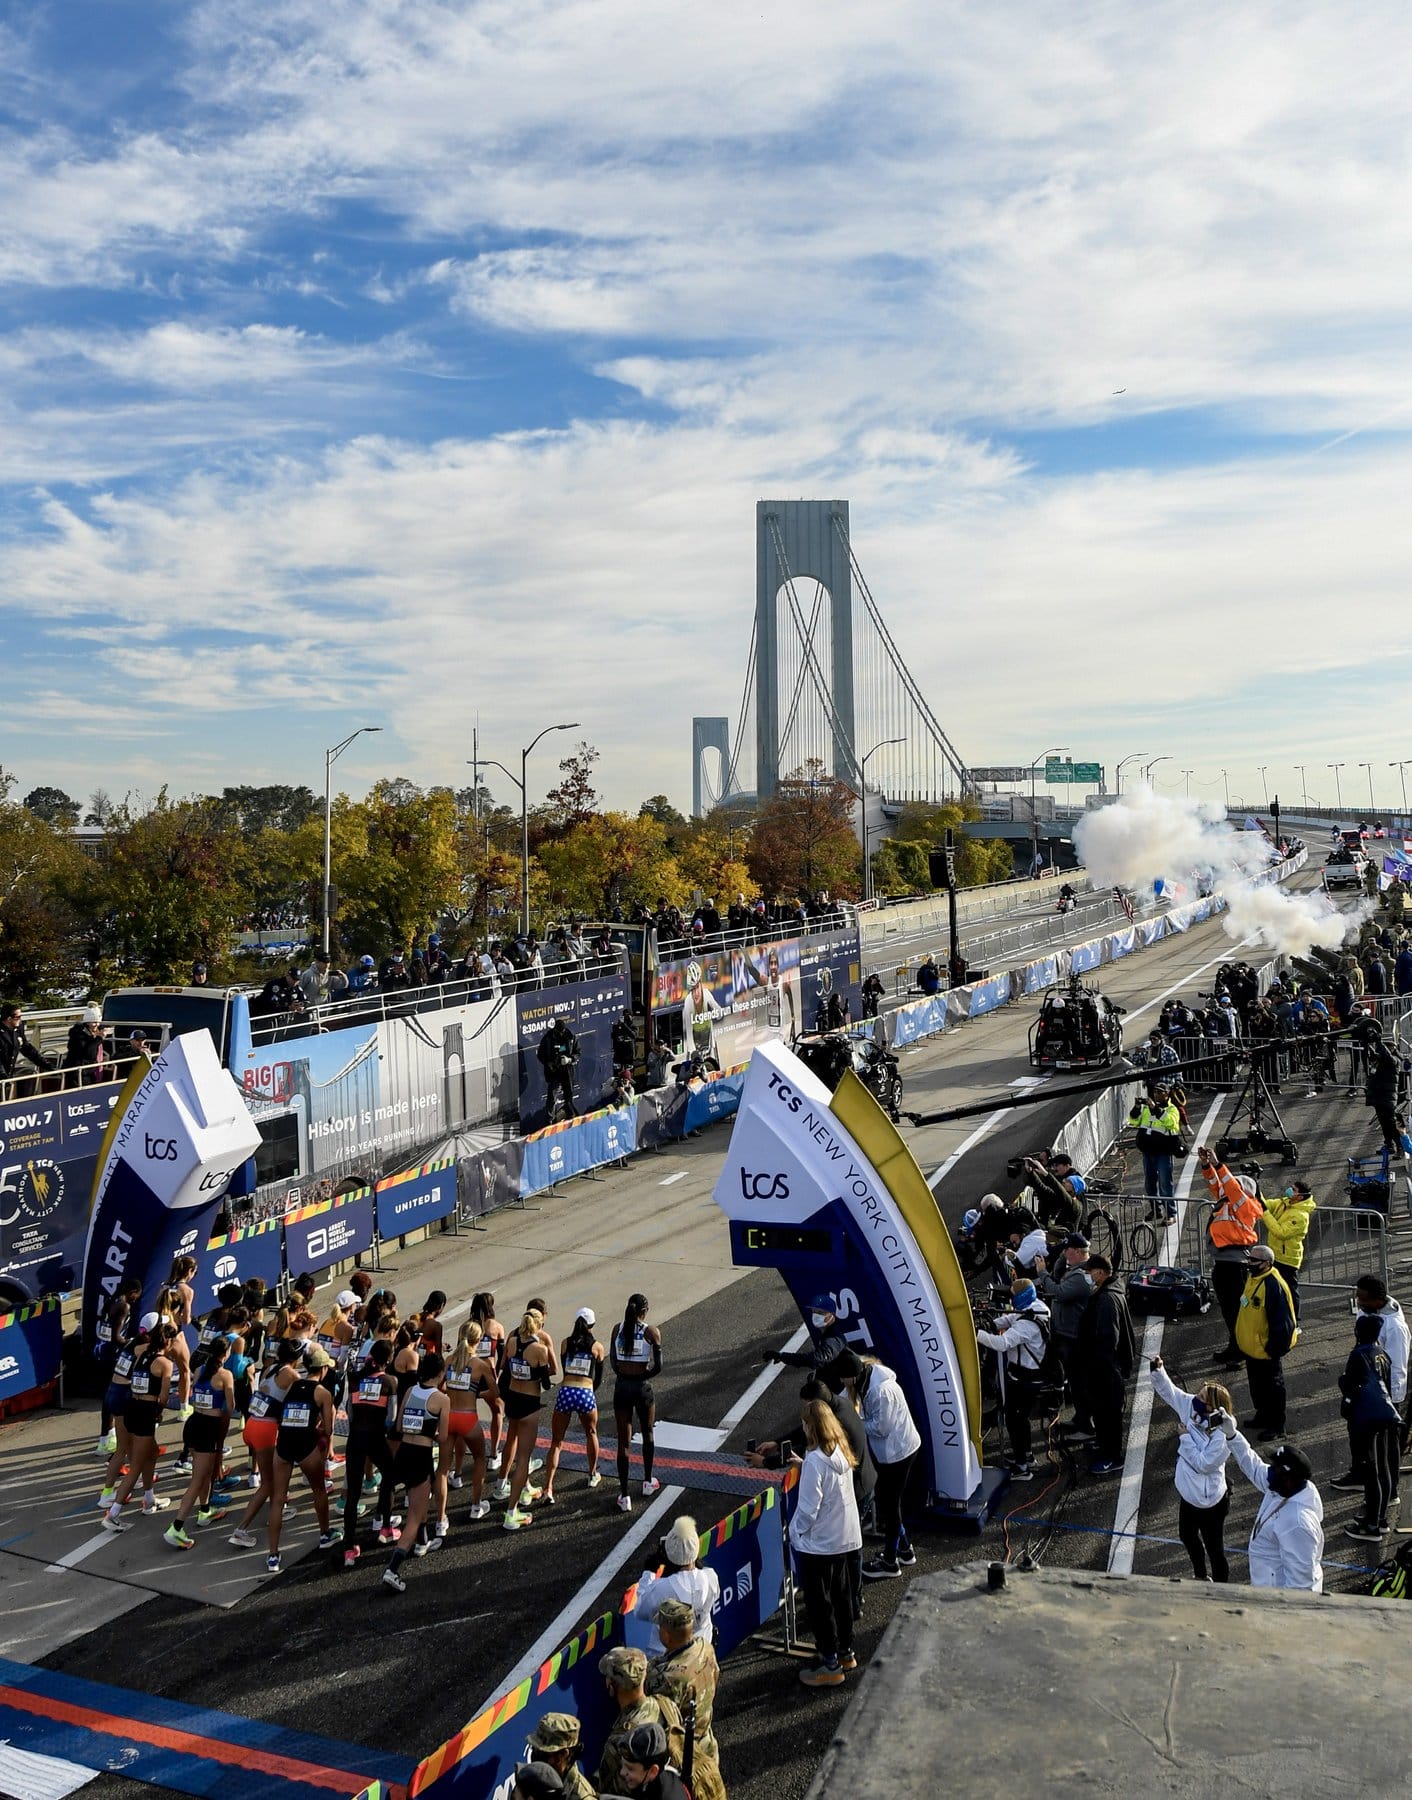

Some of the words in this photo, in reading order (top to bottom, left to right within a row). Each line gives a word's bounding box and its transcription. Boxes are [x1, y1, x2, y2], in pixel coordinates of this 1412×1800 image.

[522, 1007, 547, 1021] WATCH
[547, 1005, 554, 1016] IT
[554, 1002, 571, 1014] NOV.
[570, 1000, 575, 1010] 7
[720, 1004, 732, 1018] run
[732, 1001, 750, 1014] these
[522, 1021, 547, 1035] 8:30AM
[243, 1065, 271, 1090] BIG
[118, 1056, 169, 1148] MARATHON
[4, 1113, 42, 1133] NOV.
[43, 1110, 53, 1124] 7
[308, 1115, 358, 1140] History
[361, 1109, 372, 1126] is
[374, 1098, 409, 1121] made
[412, 1093, 441, 1111] here.
[9, 1132, 42, 1144] COVERAGE
[9, 1141, 32, 1152] STARTS
[33, 1139, 41, 1147] AT
[42, 1137, 54, 1146] 7AM
[145, 1132, 178, 1161] tcs
[358, 1137, 382, 1151] YEARS
[383, 1127, 415, 1142] RUNNING
[36, 1158, 54, 1168] TCS
[549, 1159, 564, 1173] TATA
[53, 1165, 65, 1182] NEW
[740, 1166, 790, 1200] tcs
[18, 1173, 36, 1217] MARATHON
[53, 1184, 65, 1208] YORK
[394, 1194, 431, 1214] UNITED
[36, 1206, 54, 1217] CITY
[22, 1230, 39, 1239] TATA
[173, 1243, 196, 1259] TATA
[768, 1072, 803, 1113] TCS
[802, 1112, 846, 1161] NEW
[844, 1164, 887, 1230] YORK
[882, 1235, 917, 1286] CITY
[908, 1297, 959, 1447] MARATHON
